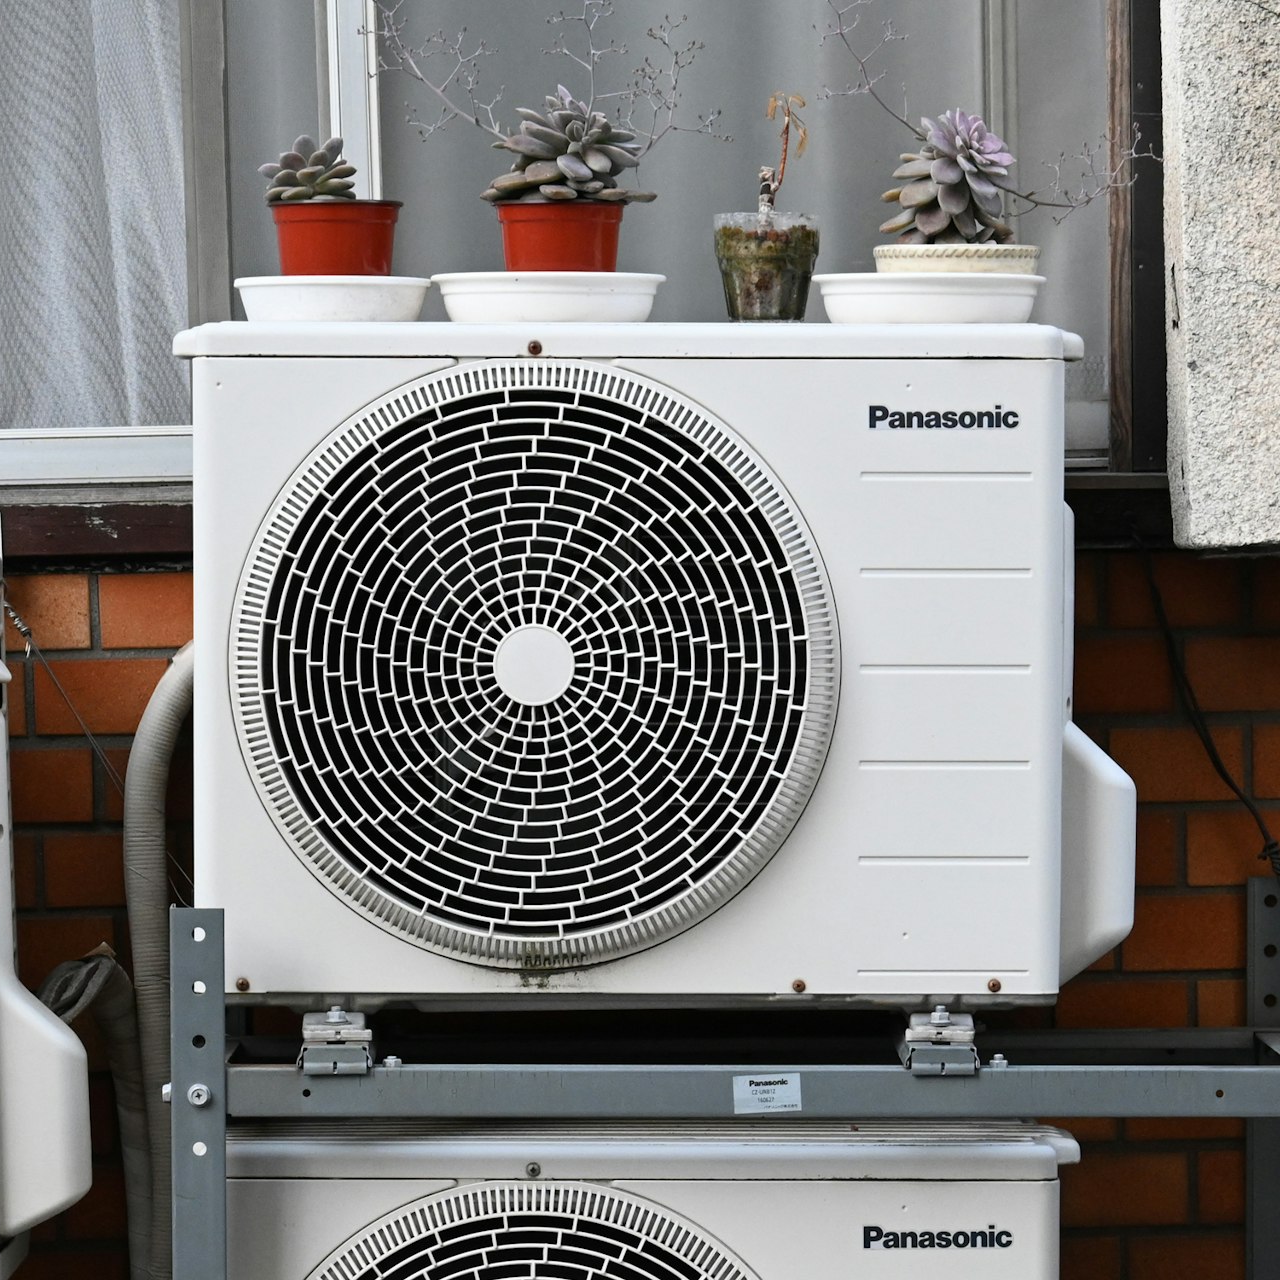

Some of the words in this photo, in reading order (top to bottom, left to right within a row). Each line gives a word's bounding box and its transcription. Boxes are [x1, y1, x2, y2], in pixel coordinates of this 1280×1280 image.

[869, 405, 1019, 429] Panasonic
[749, 1079, 788, 1087] Panasonic
[863, 1225, 1013, 1249] Panasonic
